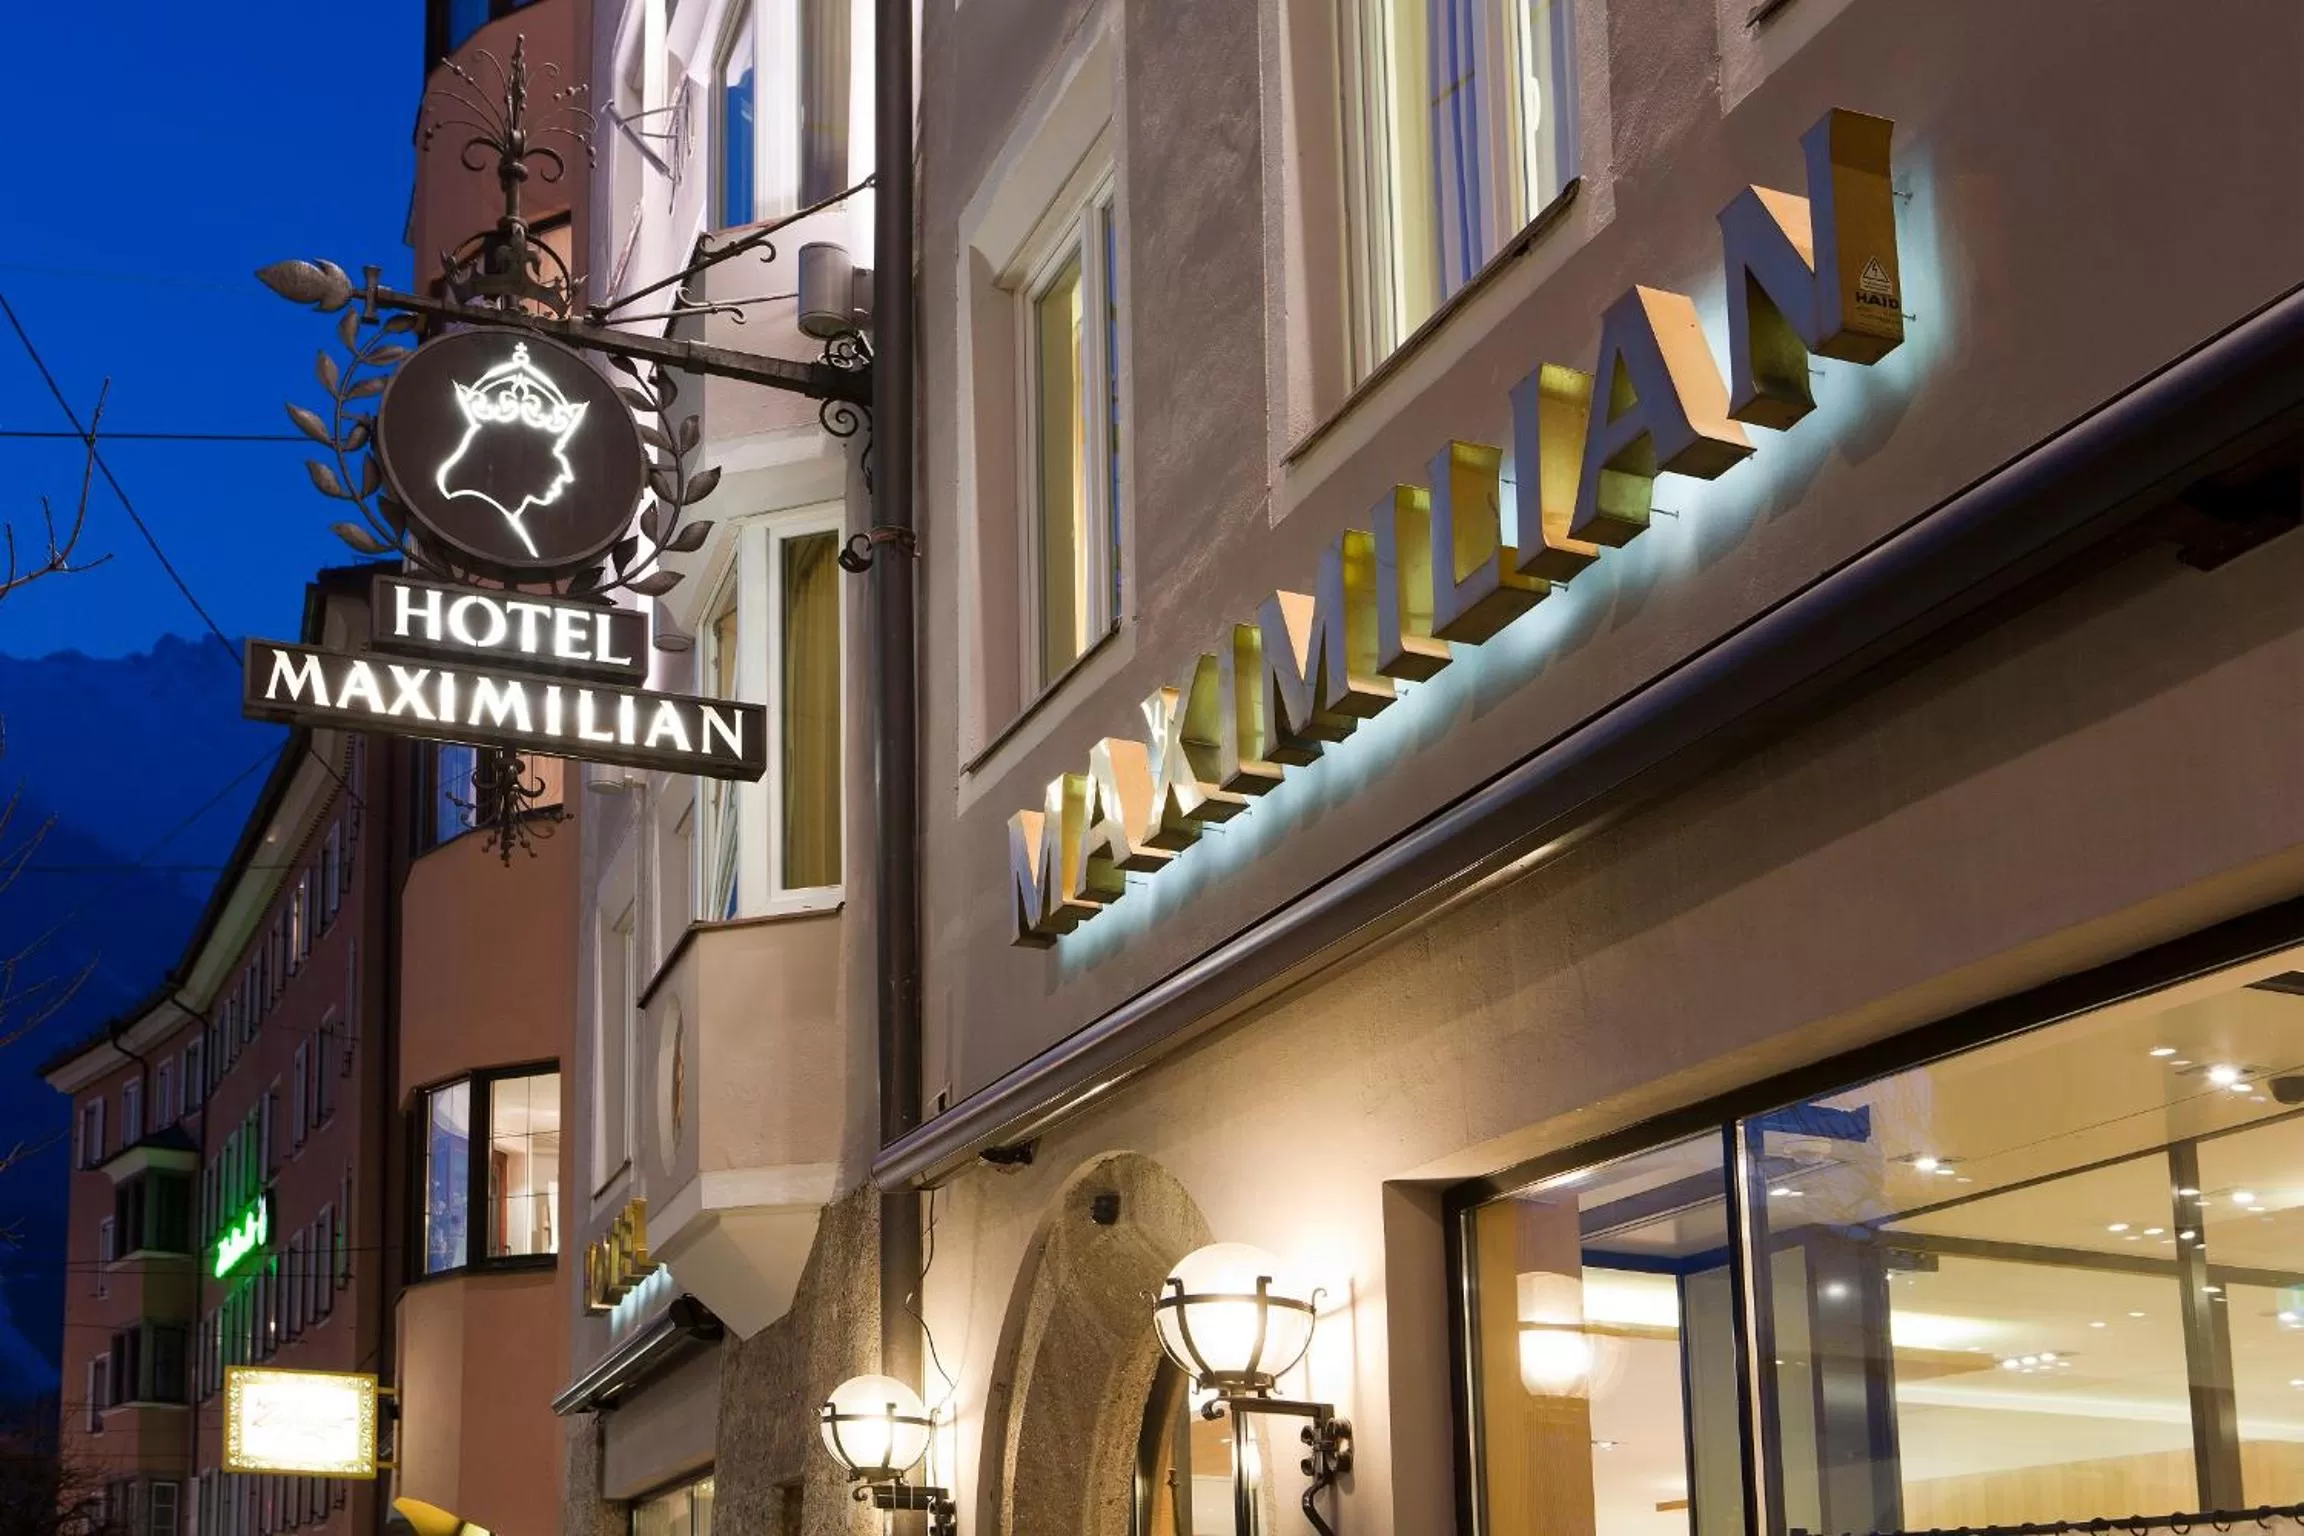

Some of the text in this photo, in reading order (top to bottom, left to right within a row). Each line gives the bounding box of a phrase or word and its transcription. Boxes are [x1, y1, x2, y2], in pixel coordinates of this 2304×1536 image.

[1009, 108, 1904, 948] MAXIMILIAN
[393, 585, 631, 667] HOTEL
[264, 649, 745, 761] MAXIMILIAN
